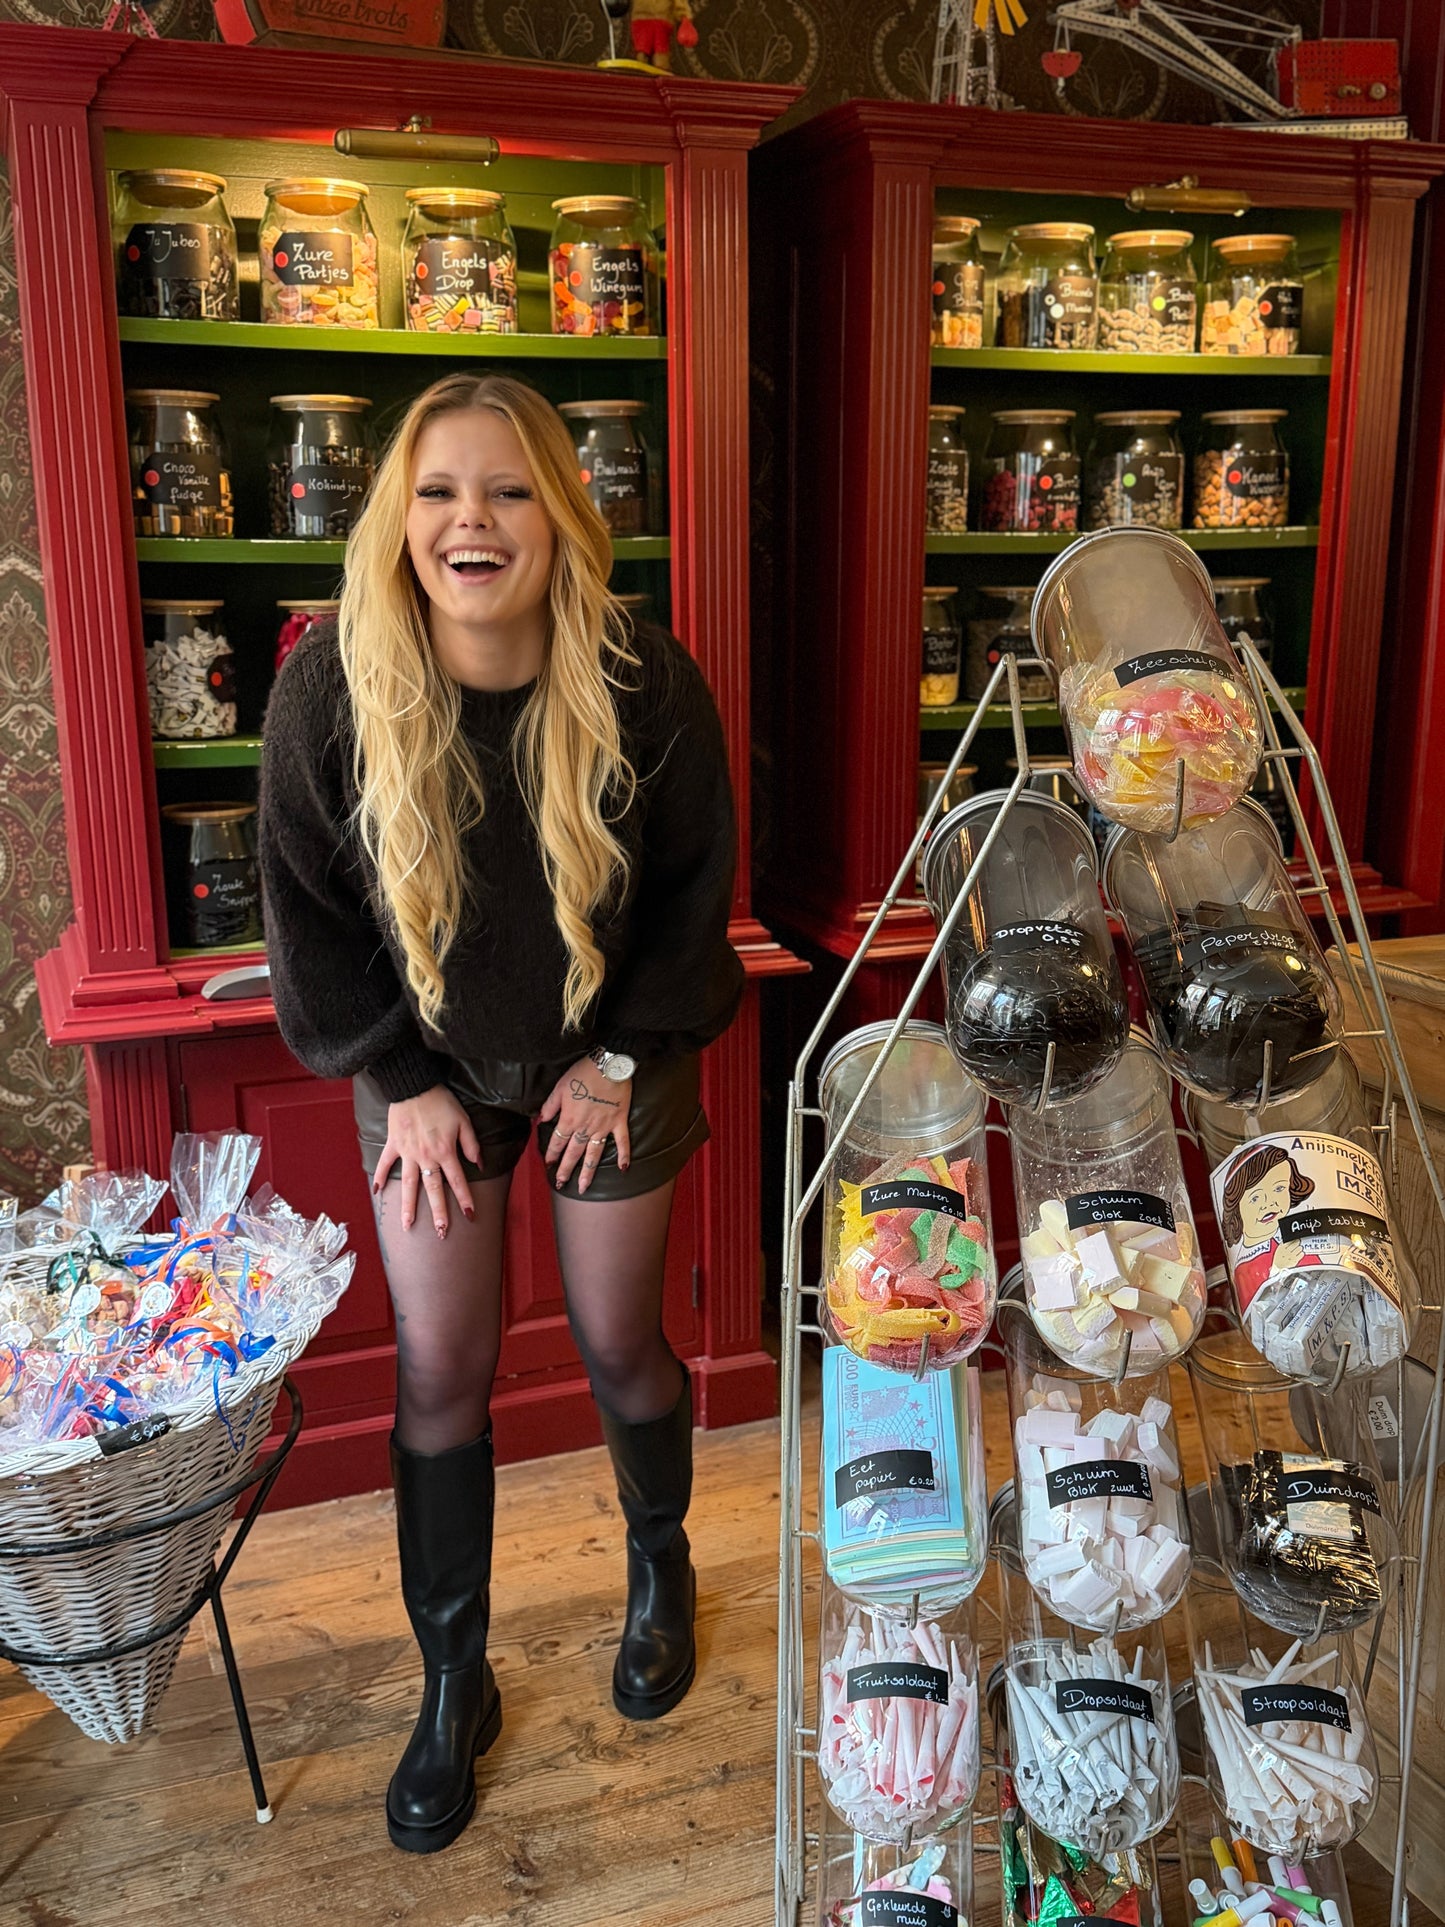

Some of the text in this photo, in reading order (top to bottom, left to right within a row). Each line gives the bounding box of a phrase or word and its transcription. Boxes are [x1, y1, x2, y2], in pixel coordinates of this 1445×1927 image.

[355, 0, 409, 28] trots
[292, 242, 335, 262] Zure
[293, 264, 349, 283] Partjes
[441, 250, 487, 278] Engels
[591, 257, 640, 283] Engels
[435, 274, 475, 291] Drop
[163, 461, 196, 474] Choco
[170, 487, 204, 502] fudge
[870, 1187, 950, 1204] Zure Matten
[1077, 1195, 1144, 1211] Schuim
[1328, 1215, 1366, 1230] tablet
[845, 1356, 860, 1381] 200
[850, 1383, 860, 1410] EURO
[1376, 1401, 1396, 1437] Duim drop
[849, 1460, 876, 1478] Eet
[1053, 1466, 1120, 1489] Schuim
[854, 1470, 897, 1493] papier
[1110, 1483, 1138, 1494] zuur
[1286, 1479, 1373, 1506] Duimdrop
[853, 1671, 939, 1691] Fruitsoldaat
[1062, 1688, 1147, 1711] Dropsoldaat
[1252, 1696, 1348, 1720] Stroopsoldaat
[866, 1897, 927, 1919] Gekleurde
[895, 1913, 928, 1927] muis
